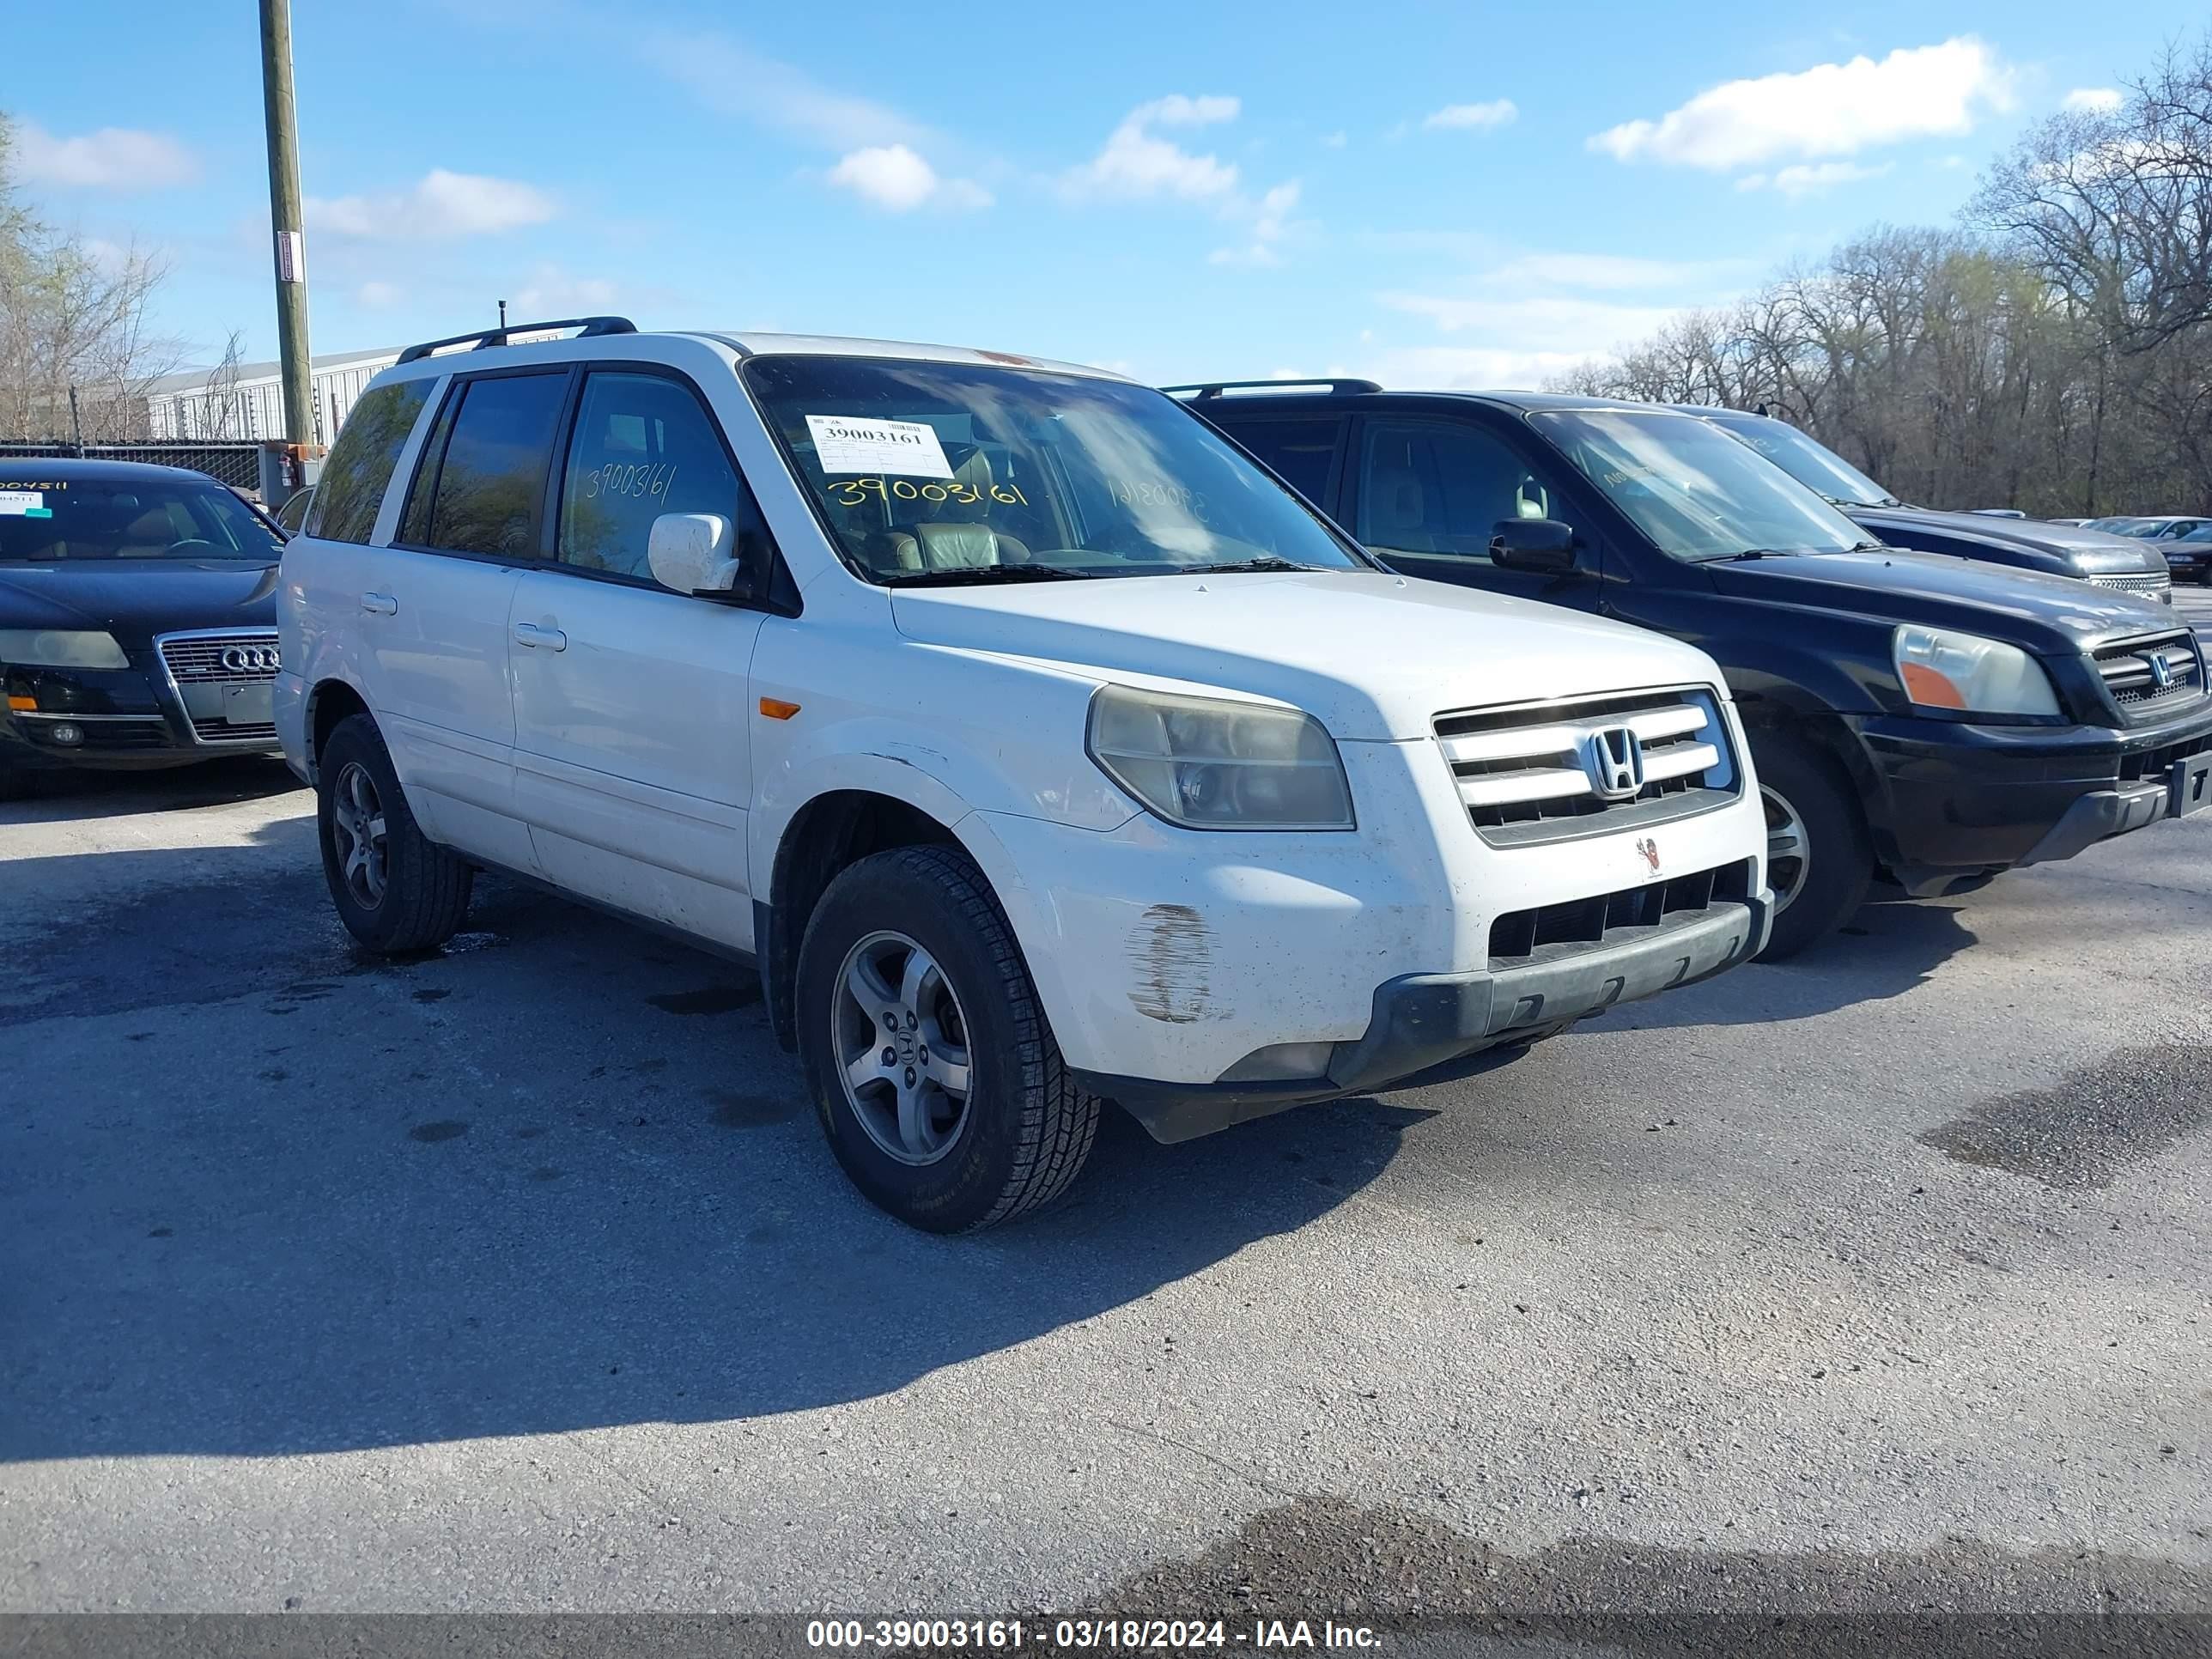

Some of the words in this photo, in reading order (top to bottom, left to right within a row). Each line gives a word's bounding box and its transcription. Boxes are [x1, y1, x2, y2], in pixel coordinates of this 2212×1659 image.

[824, 428, 921, 445] 39003161
[586, 463, 677, 507] 39003161
[827, 478, 1029, 506] 39003161
